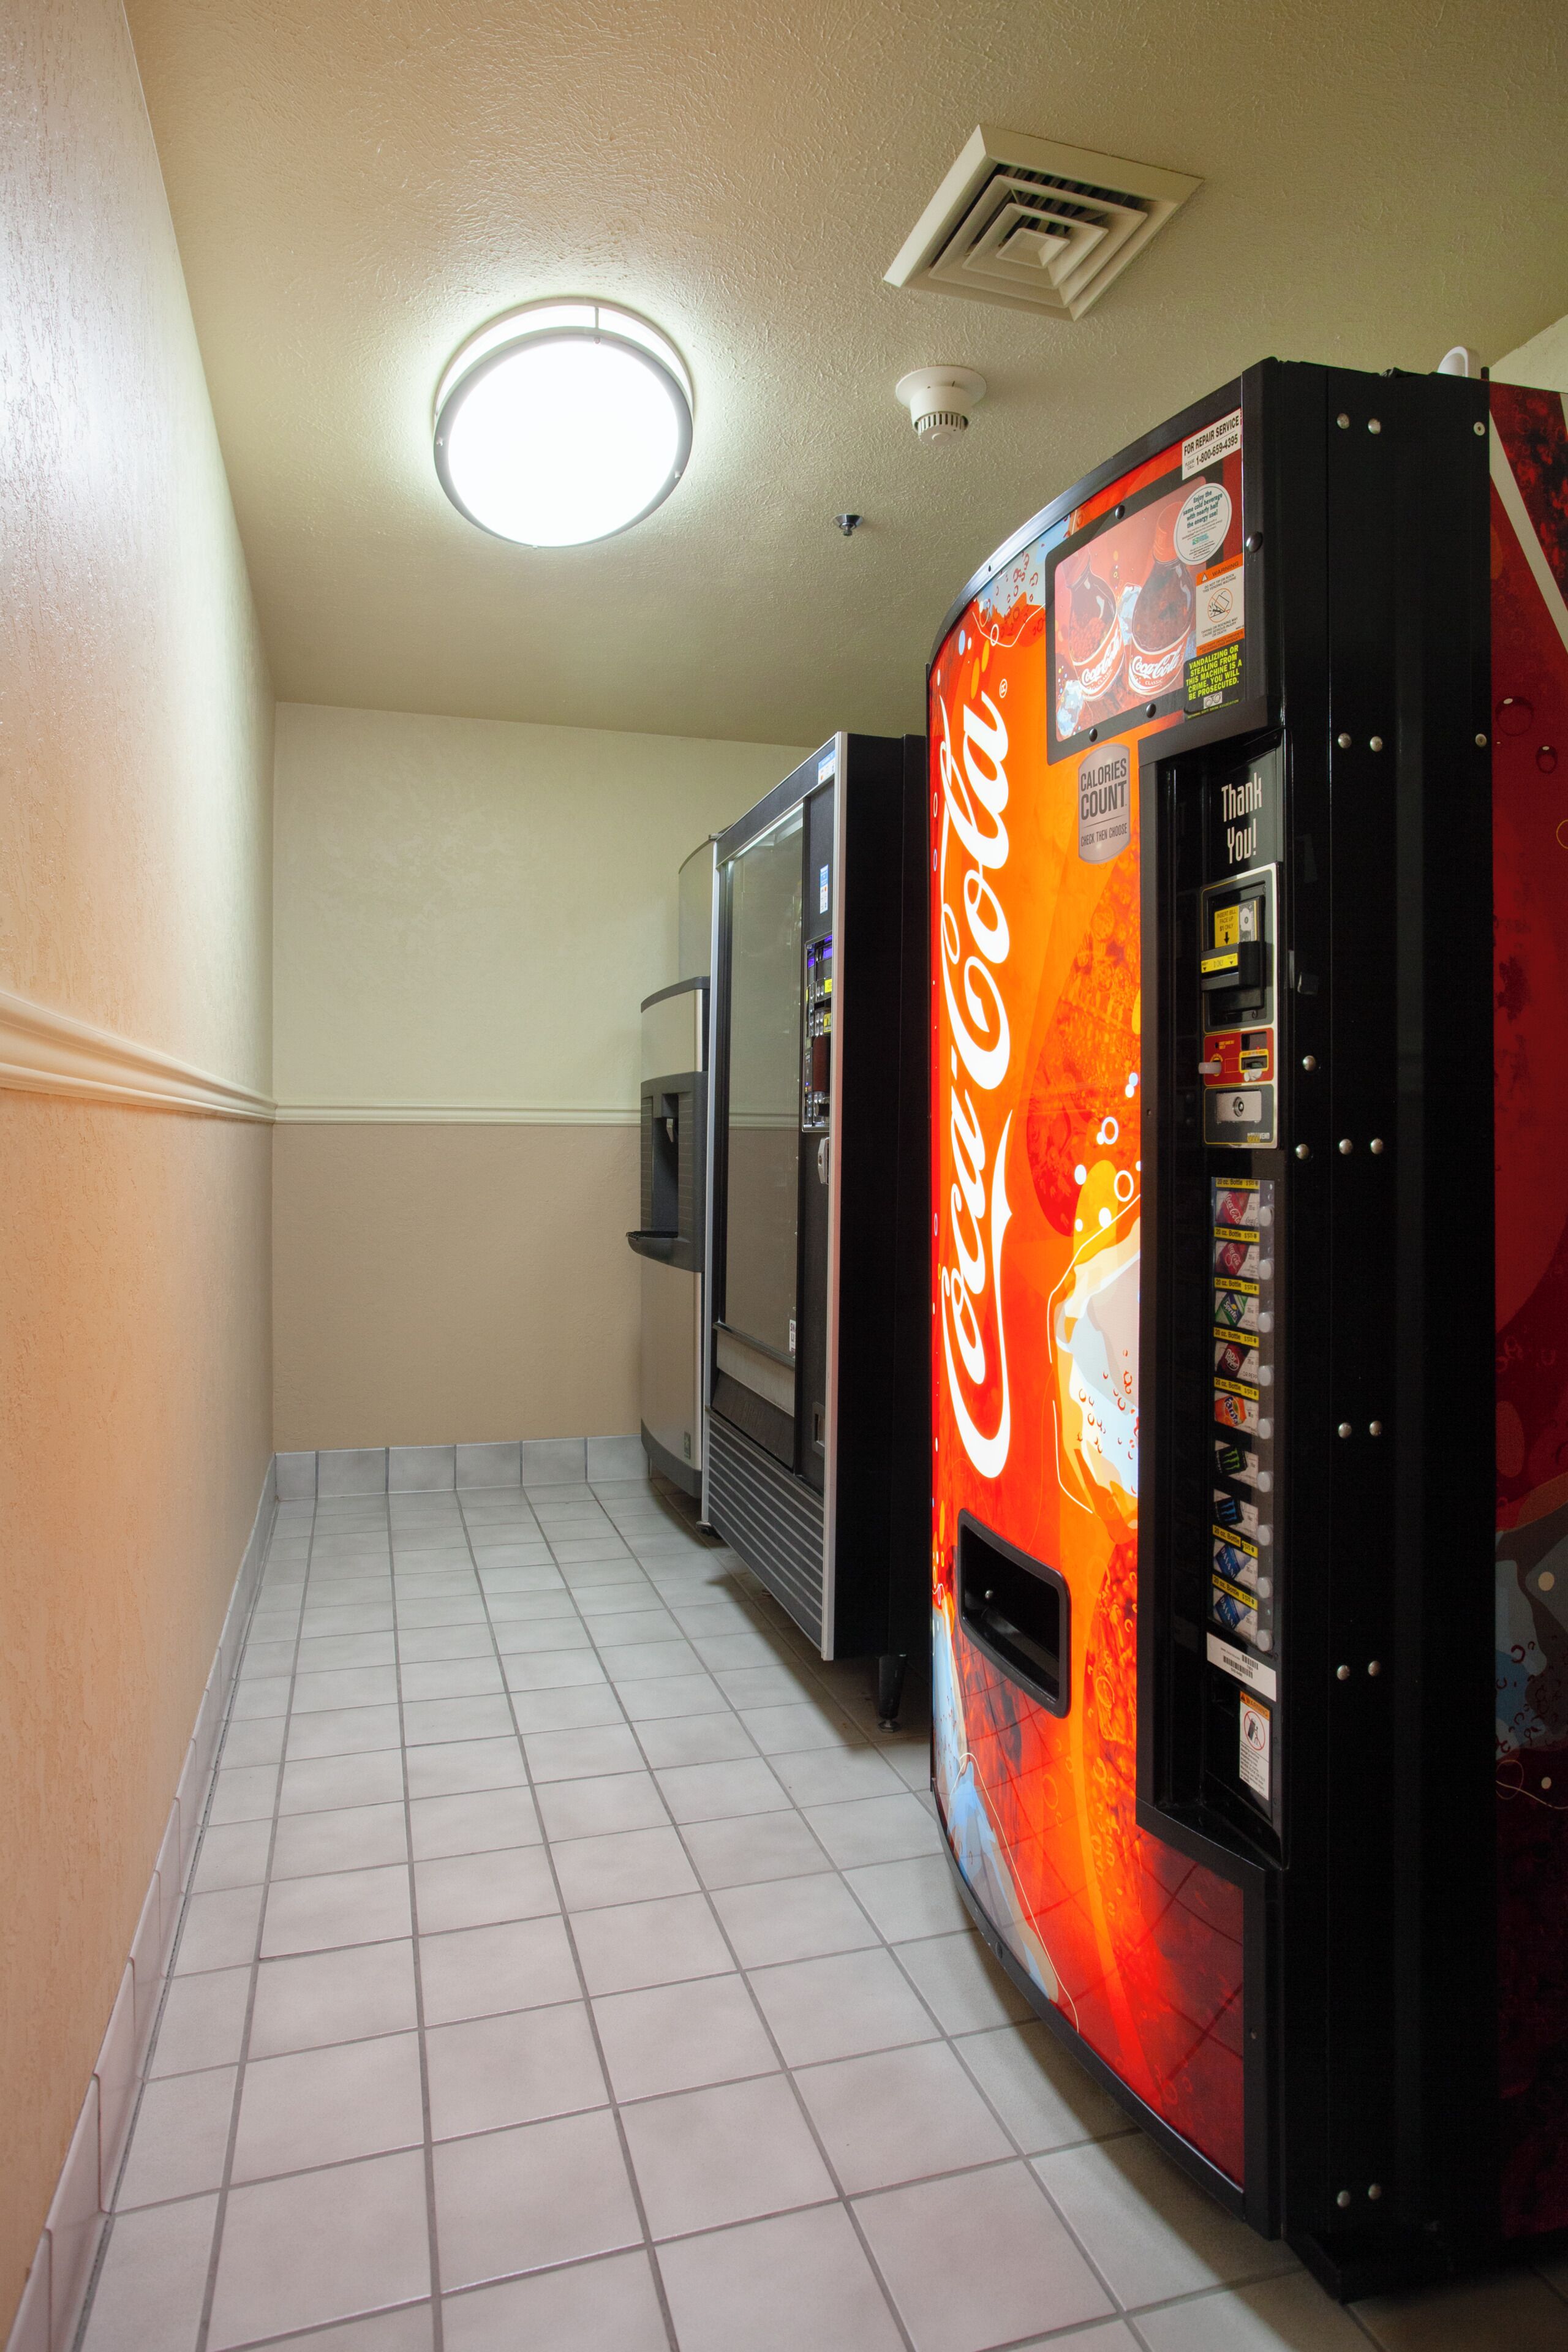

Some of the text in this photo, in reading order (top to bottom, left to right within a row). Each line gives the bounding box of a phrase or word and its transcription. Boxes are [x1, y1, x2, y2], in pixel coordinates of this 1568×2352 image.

[1184, 415, 1239, 456] FOR REPAIR SERVICE
[1196, 434, 1238, 466] 1-800-659-4395
[1183, 507, 1193, 516] same
[1204, 493, 1223, 506] beverage
[1193, 494, 1204, 503] Enjoy
[1187, 501, 1218, 521] with nearly half
[1194, 515, 1208, 525] energy
[1209, 509, 1218, 518] use!
[1212, 561, 1239, 577] WARNING
[1133, 642, 1183, 679] Coca-Cola
[1189, 649, 1227, 669] VANDALIZING
[1230, 644, 1238, 654] OR
[1191, 654, 1237, 677] STEALING FROM
[1186, 676, 1199, 686] THIS
[1200, 665, 1227, 680] MACHINE
[1188, 668, 1240, 693] CRIME. YOU WILL
[1188, 677, 1239, 701] BE PROSECUTED.
[1080, 758, 1127, 792] CALORIES
[1221, 772, 1262, 822] Thank
[1080, 823, 1128, 847] CHECK THEN CHOOSE
[1227, 818, 1256, 864] You!
[940, 691, 1012, 1477] Coca-Cola
[1225, 1194, 1242, 1224] Coca-Cola
[1224, 1301, 1237, 1319] Sprite
[1228, 1332, 1241, 1340] Bottle
[1228, 1382, 1241, 1391] Bottle
[1224, 1396, 1238, 1424] Fanta
[1227, 1533, 1240, 1544] Bottle
[1226, 1583, 1239, 1597] Bottle
